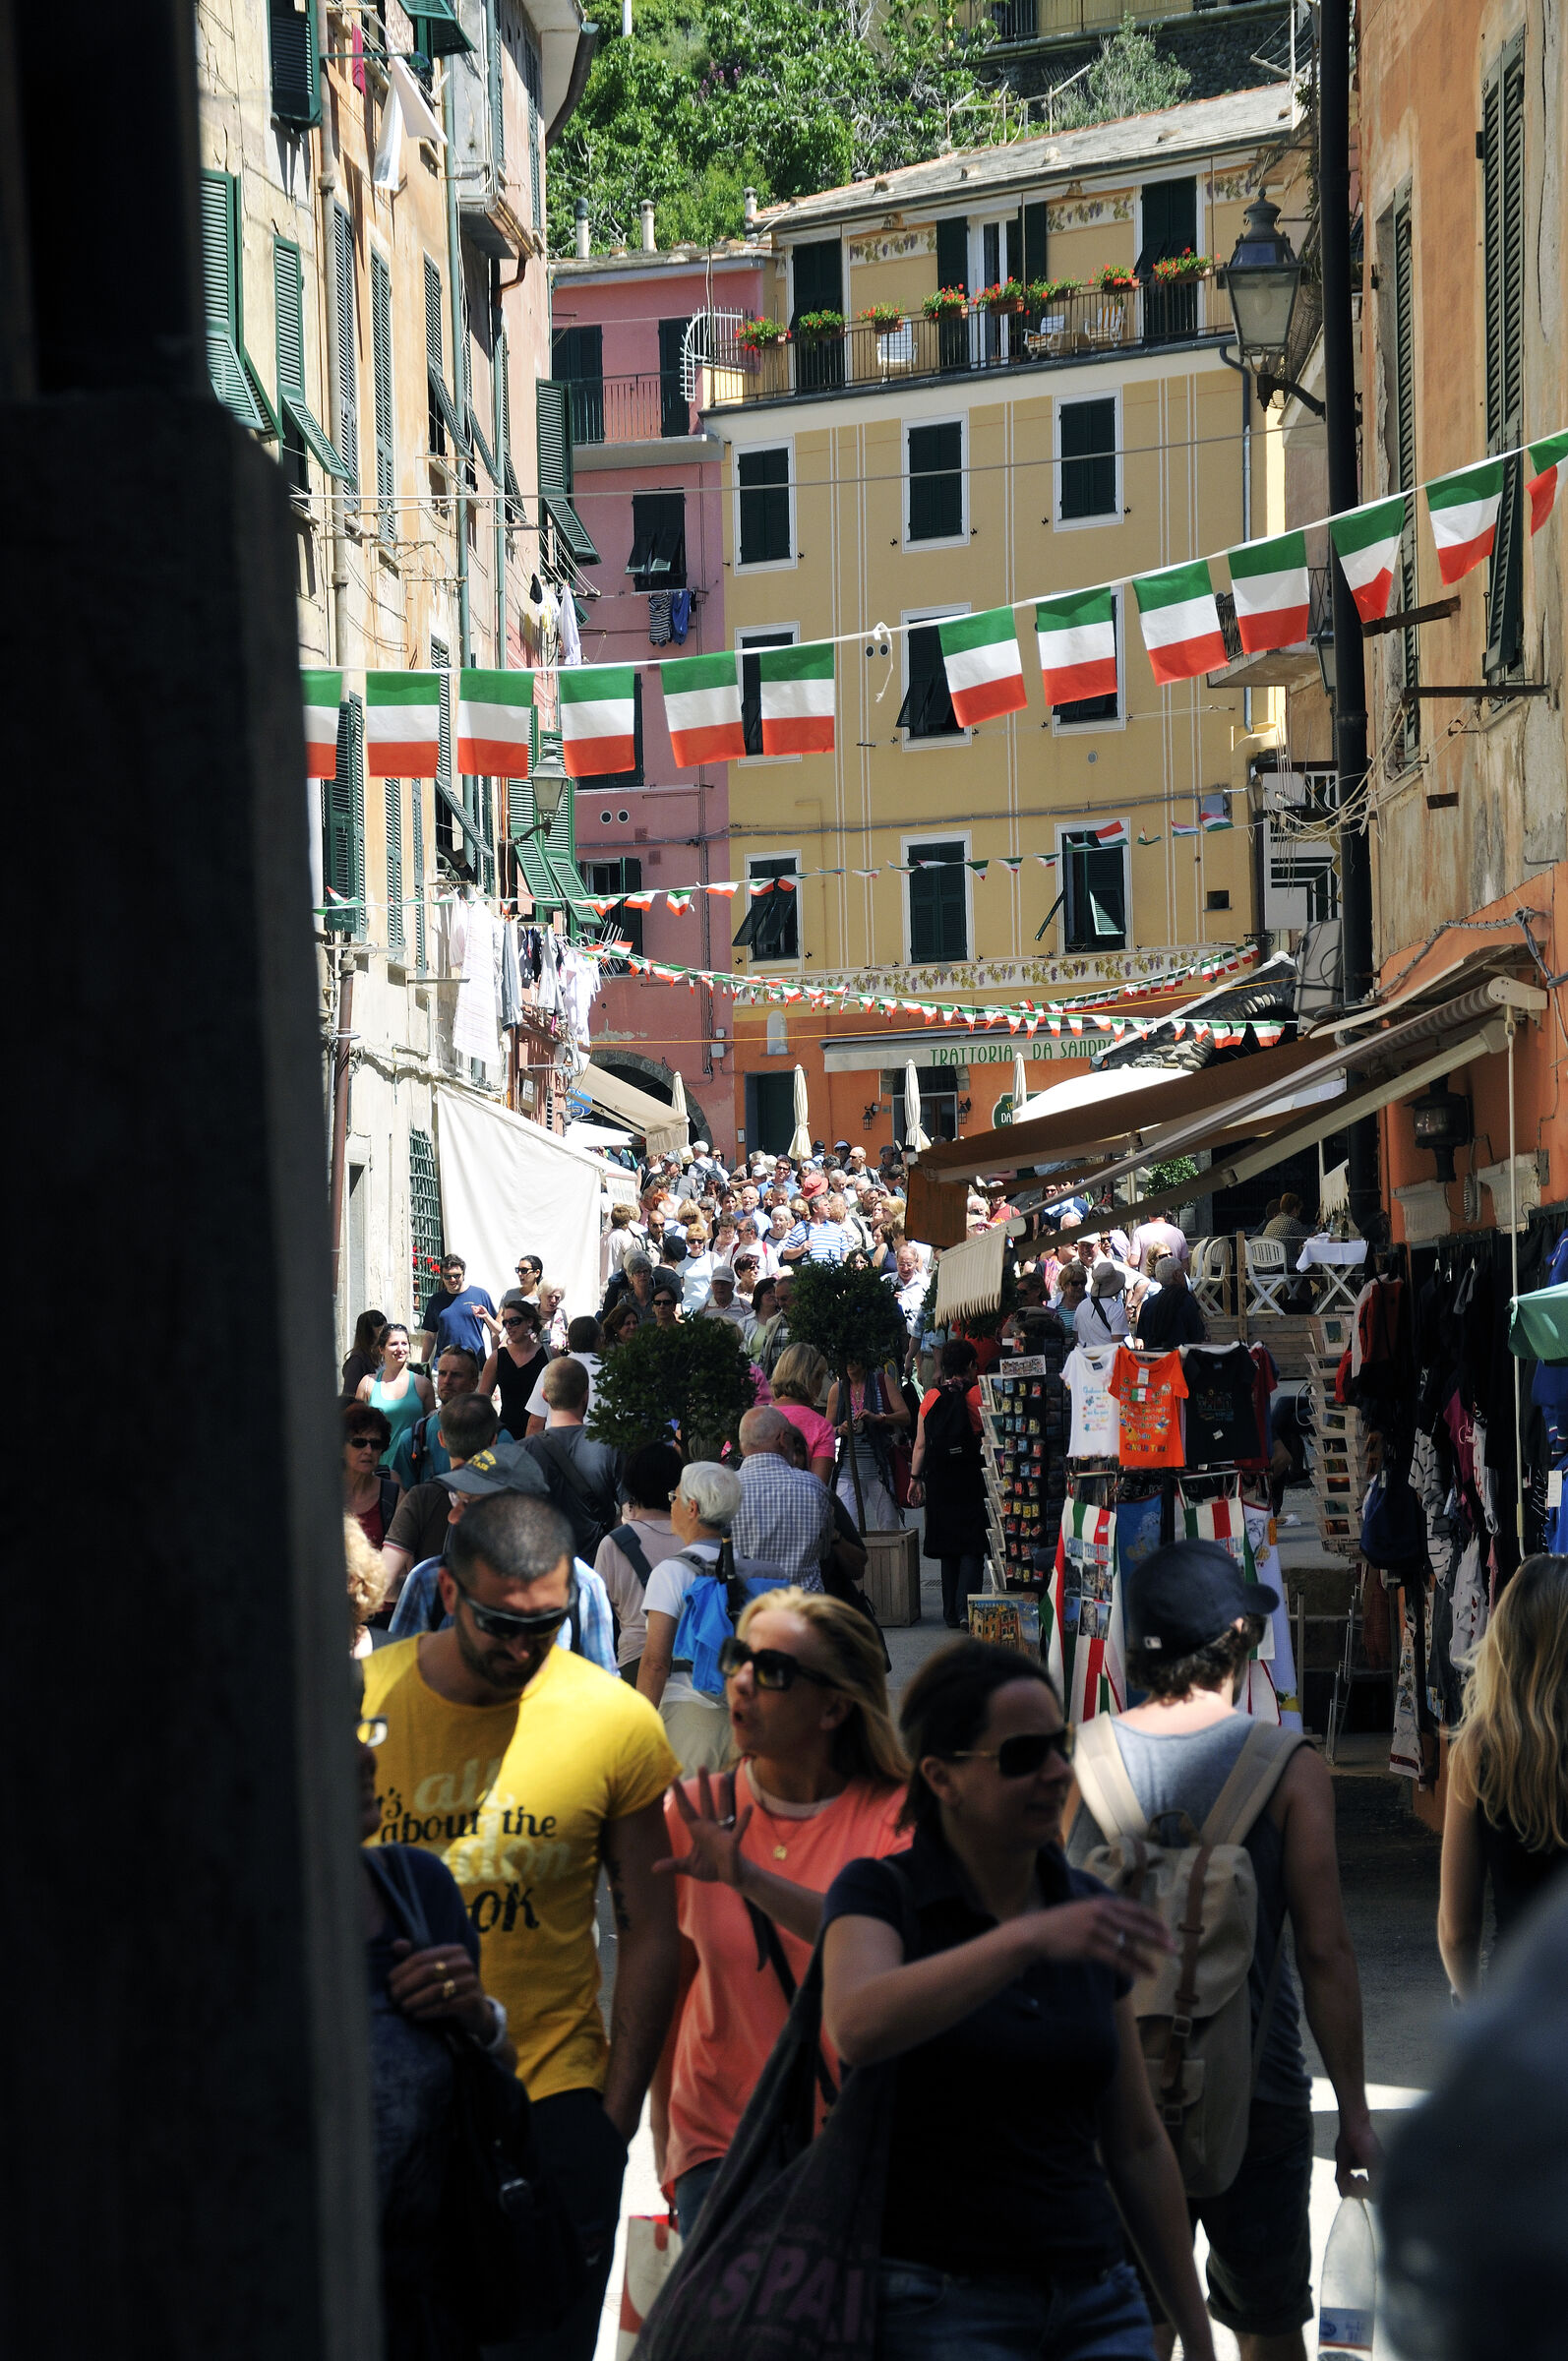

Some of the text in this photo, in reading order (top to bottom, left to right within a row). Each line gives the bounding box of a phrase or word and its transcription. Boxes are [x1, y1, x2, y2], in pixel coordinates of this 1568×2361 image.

[930, 1045, 1013, 1065] TRATTORIA
[1033, 1043, 1053, 1059] DA
[413, 1756, 515, 1813] all
[381, 1806, 557, 1845] about the
